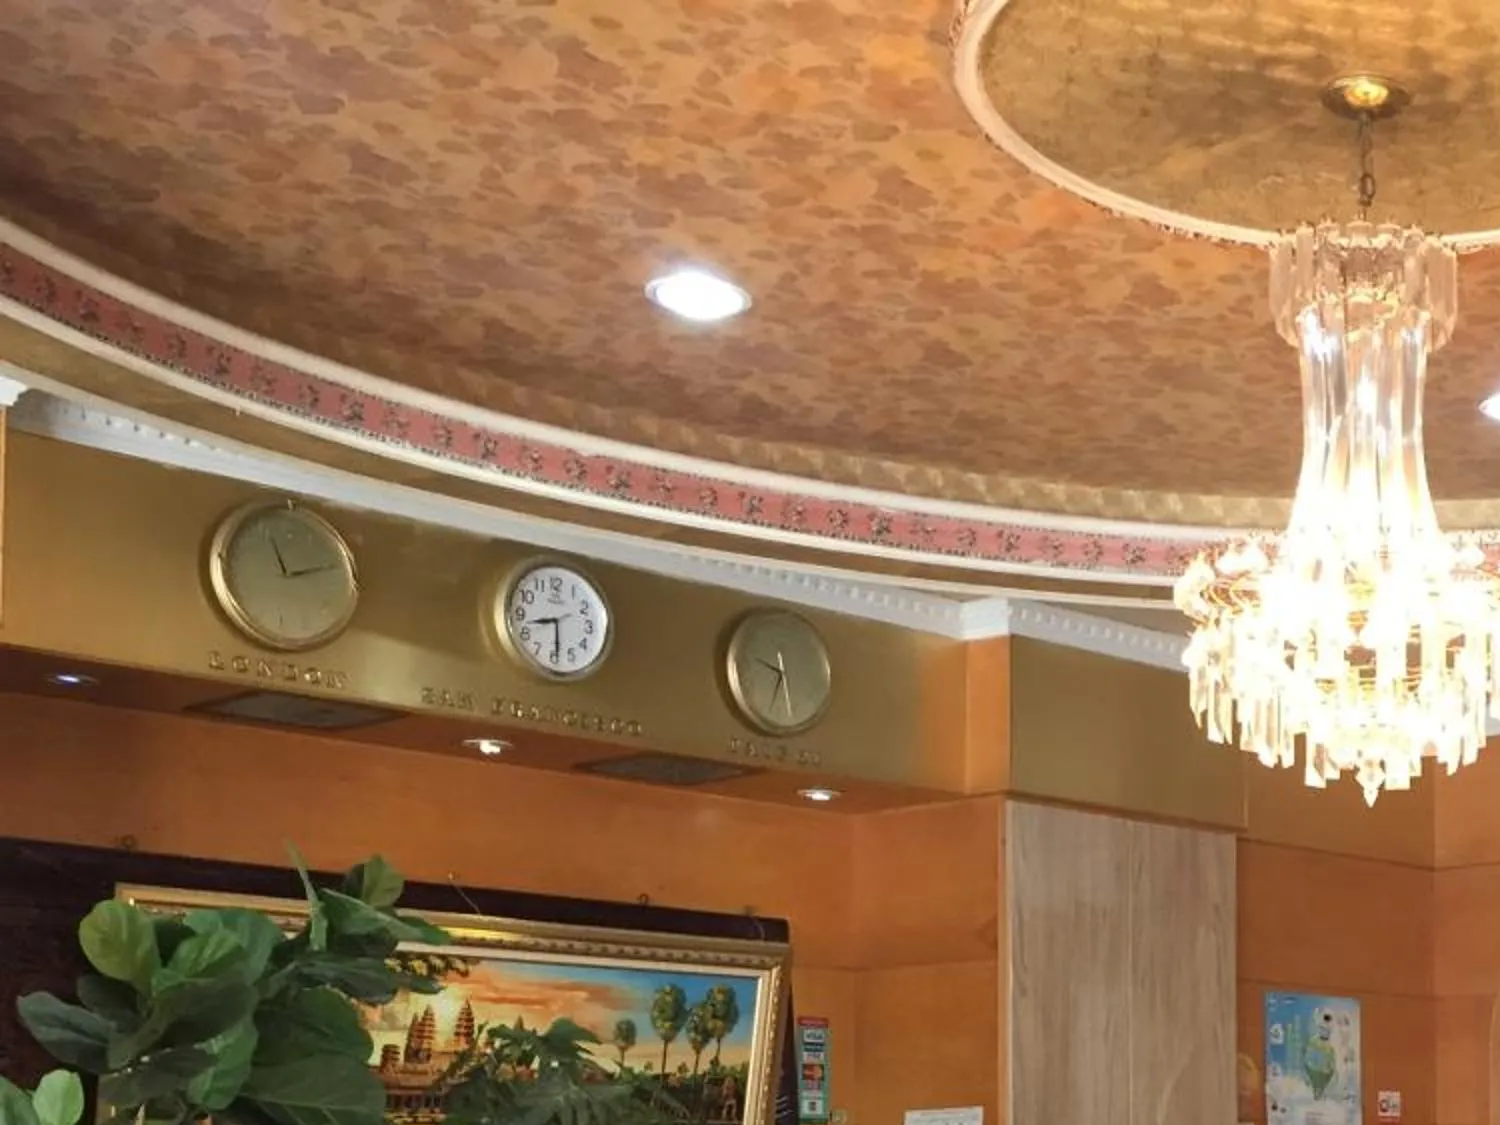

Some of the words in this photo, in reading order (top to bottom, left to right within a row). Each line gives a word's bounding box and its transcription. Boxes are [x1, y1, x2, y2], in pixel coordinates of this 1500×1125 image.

[534, 577, 545, 593] 11
[548, 576, 562, 592] 12
[519, 588, 535, 605] 10
[515, 603, 525, 621] 9
[579, 599, 589, 616] 2
[519, 625, 531, 641] 8
[584, 619, 593, 635] 3
[533, 641, 542, 656] 7
[577, 637, 588, 651] 4
[549, 649, 560, 665] 6
[567, 647, 576, 663] 5
[208, 650, 347, 689] LONDON
